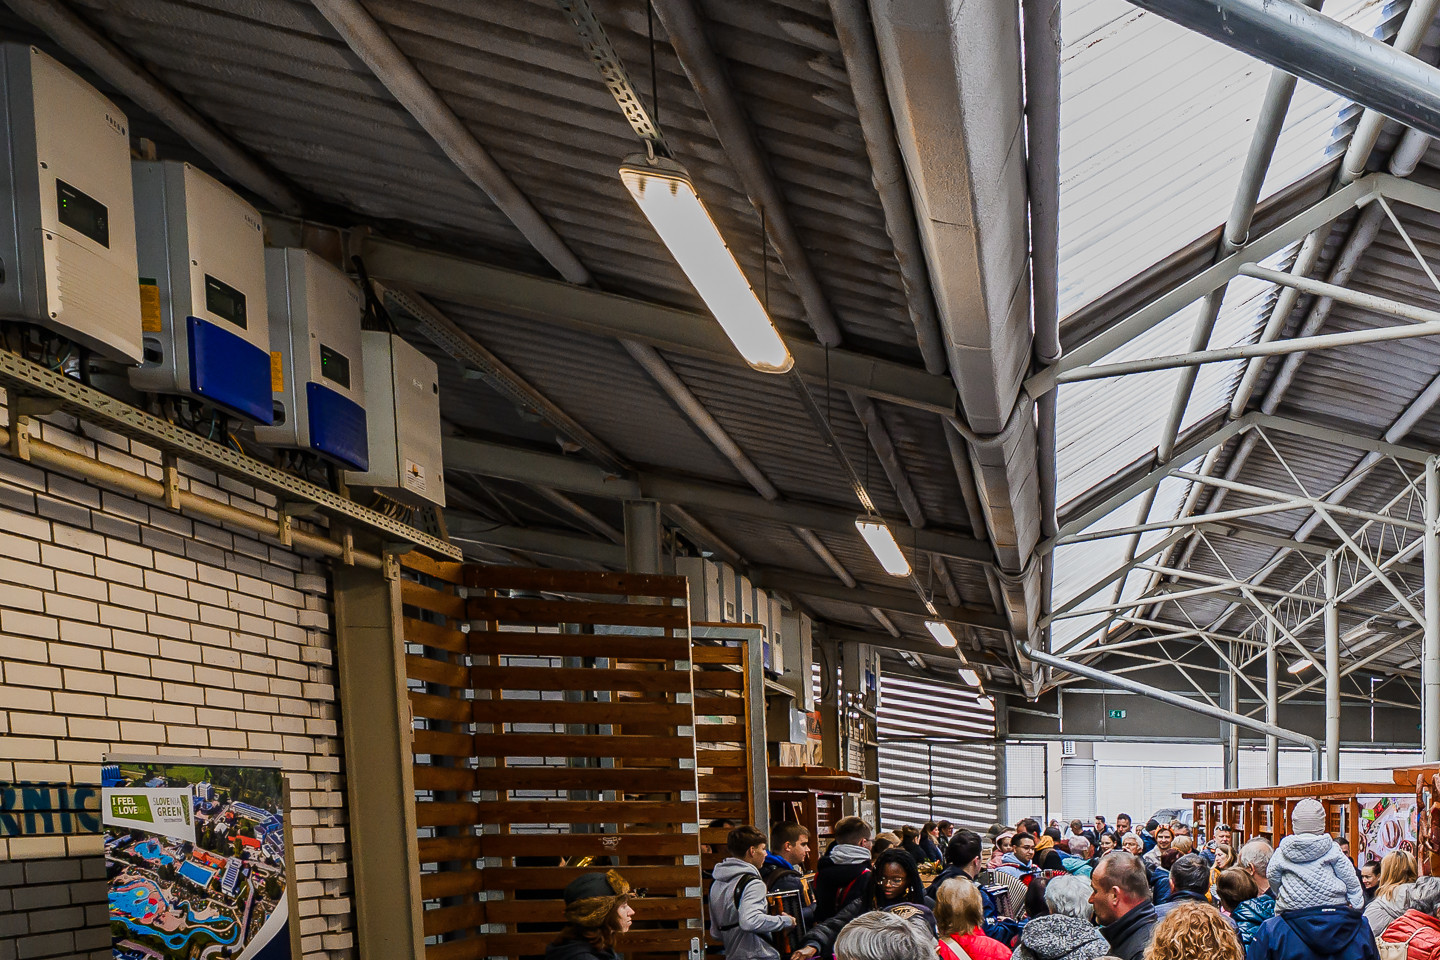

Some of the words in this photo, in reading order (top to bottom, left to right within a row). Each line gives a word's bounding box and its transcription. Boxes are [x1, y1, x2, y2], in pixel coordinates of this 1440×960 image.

[112, 797, 117, 805] I
[117, 797, 136, 806] FEEL
[157, 807, 182, 816] GREEN
